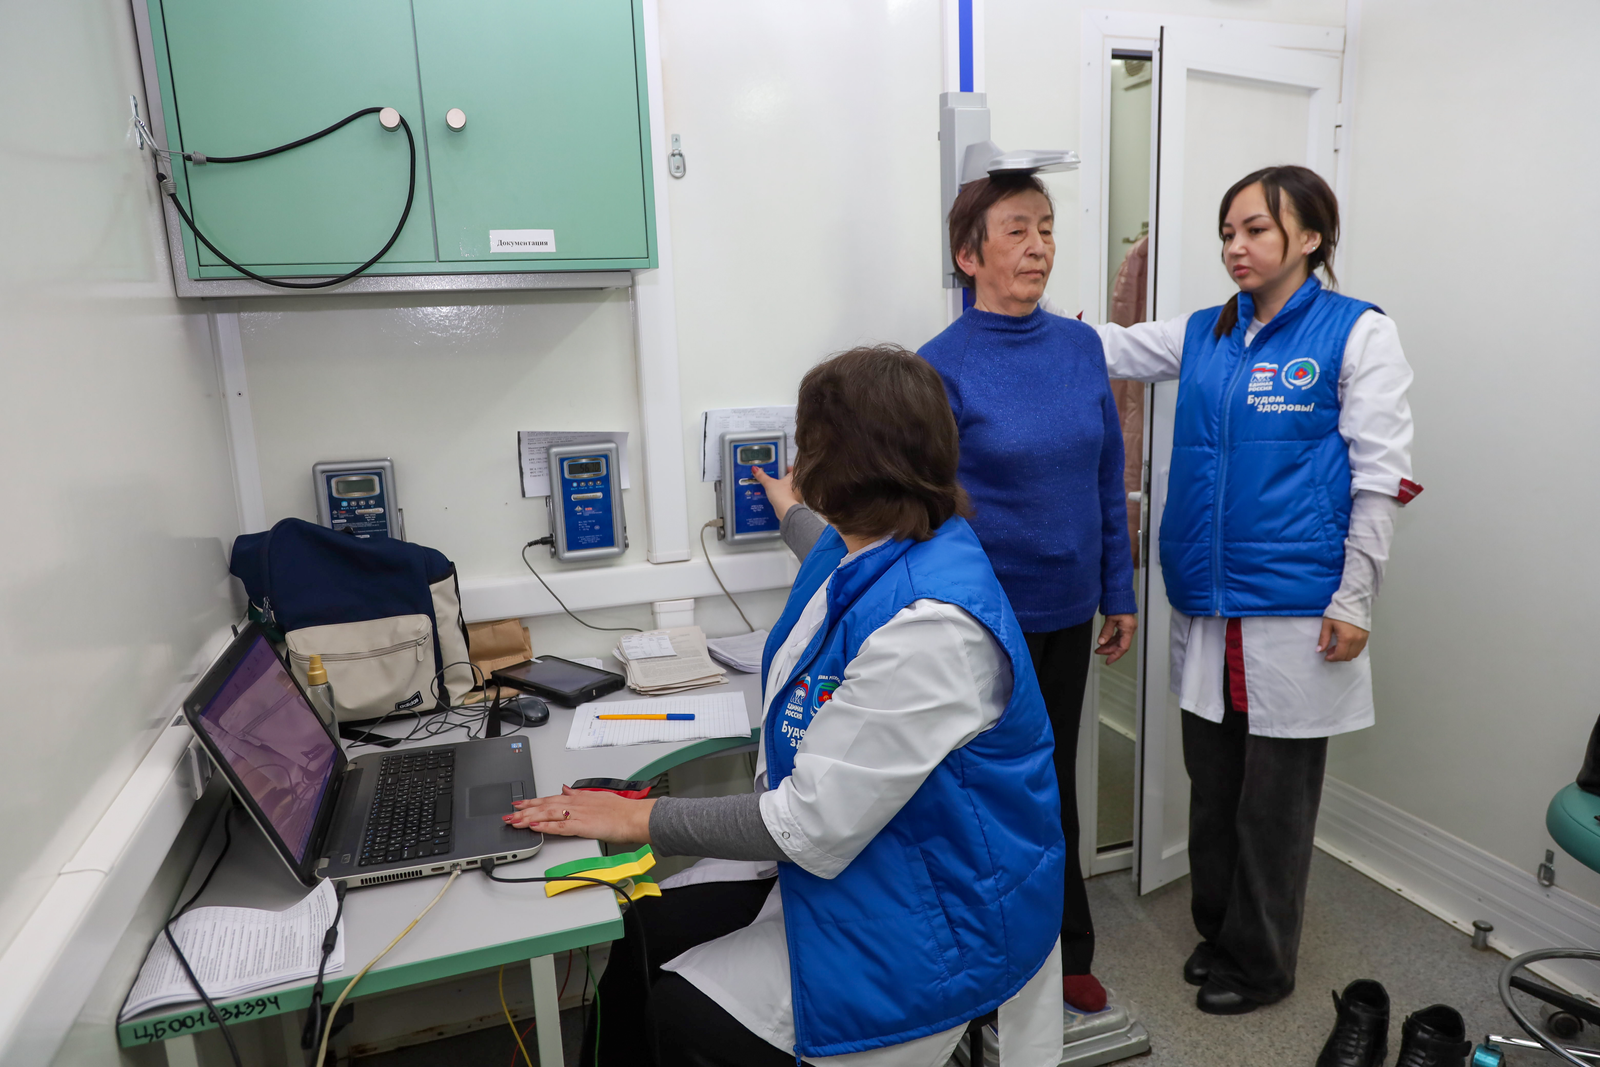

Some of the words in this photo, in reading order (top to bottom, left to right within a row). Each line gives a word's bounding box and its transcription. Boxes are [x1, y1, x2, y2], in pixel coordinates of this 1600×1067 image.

[497, 239, 548, 247] Документация
[1247, 395, 1284, 406] Будем
[1257, 402, 1314, 413] здоровы!
[400, 697, 419, 709] adidas
[785, 709, 803, 720] РОССИЯ
[781, 720, 806, 739] Буде
